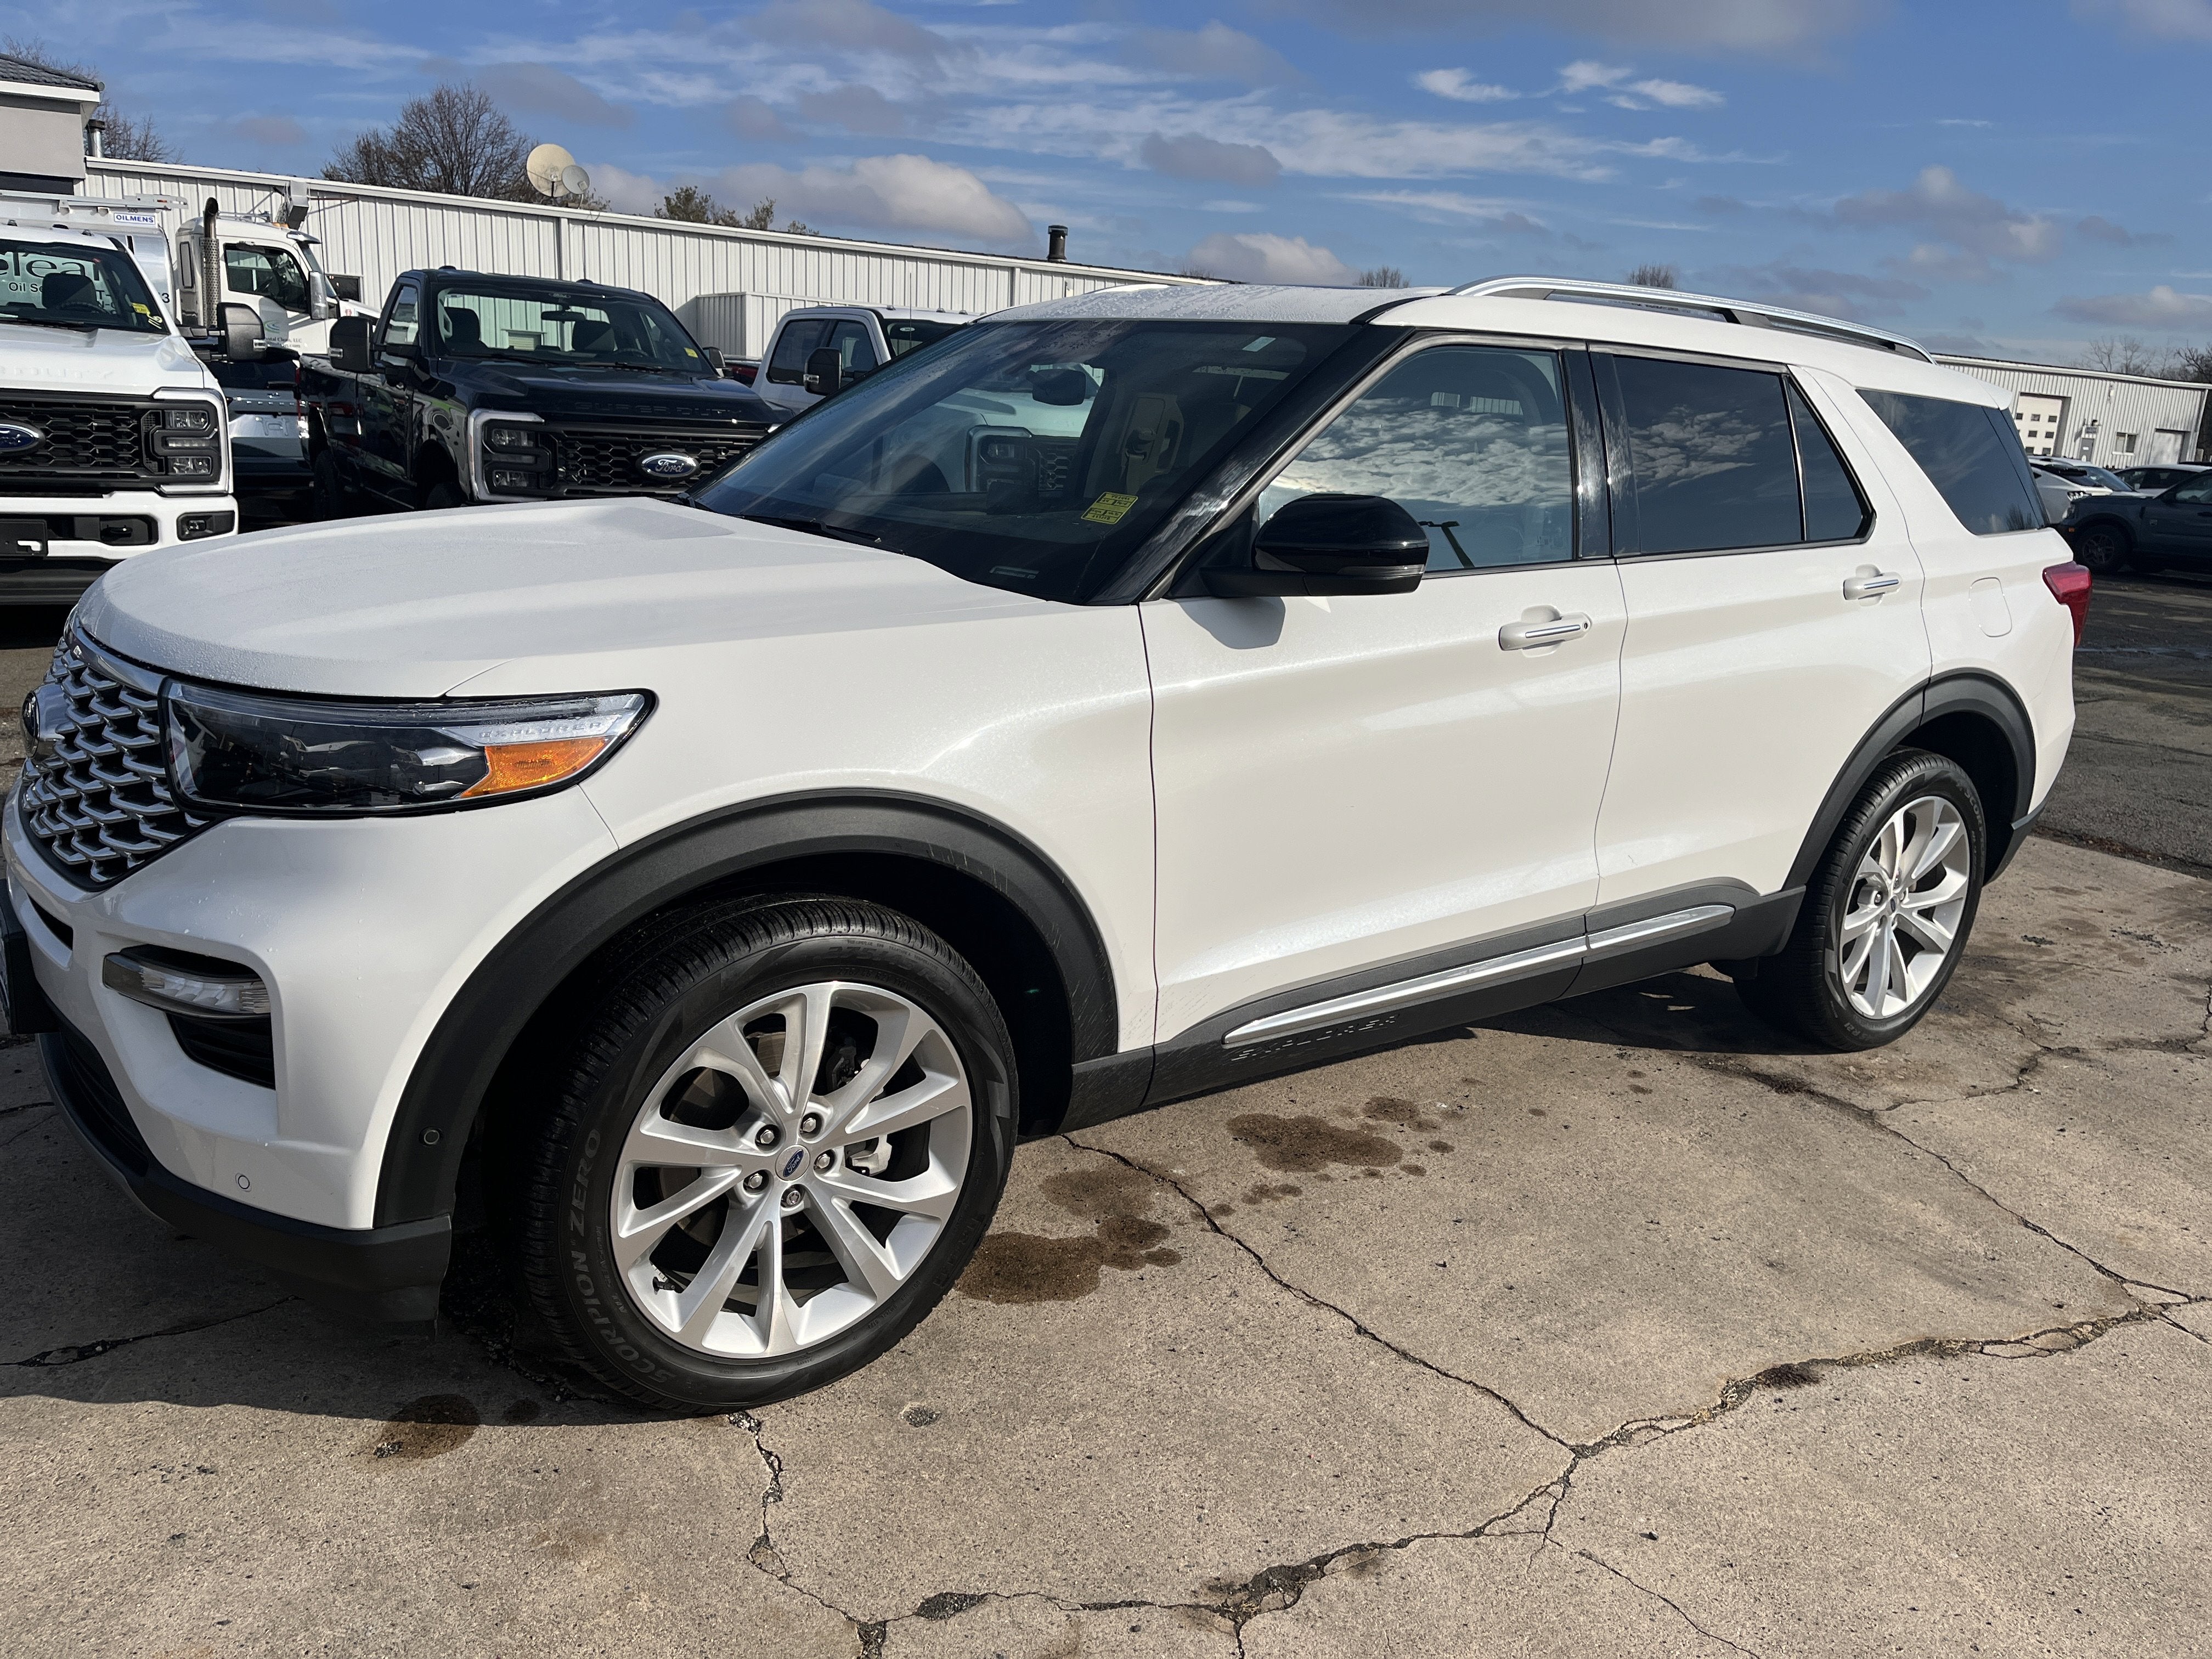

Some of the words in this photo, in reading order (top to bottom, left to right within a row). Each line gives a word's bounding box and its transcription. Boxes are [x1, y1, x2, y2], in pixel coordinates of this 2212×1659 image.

[116, 215, 154, 223] OILMENS
[9, 282, 26, 292] Oil
[575, 401, 670, 415] SUPER
[655, 459, 685, 473] Ford
[478, 721, 602, 738] EXPLORER
[1231, 1014, 1400, 1061] EXPLORER
[787, 1154, 800, 1173] Ford
[569, 1128, 601, 1238] ZERO
[571, 1249, 676, 1386] SCORPION
